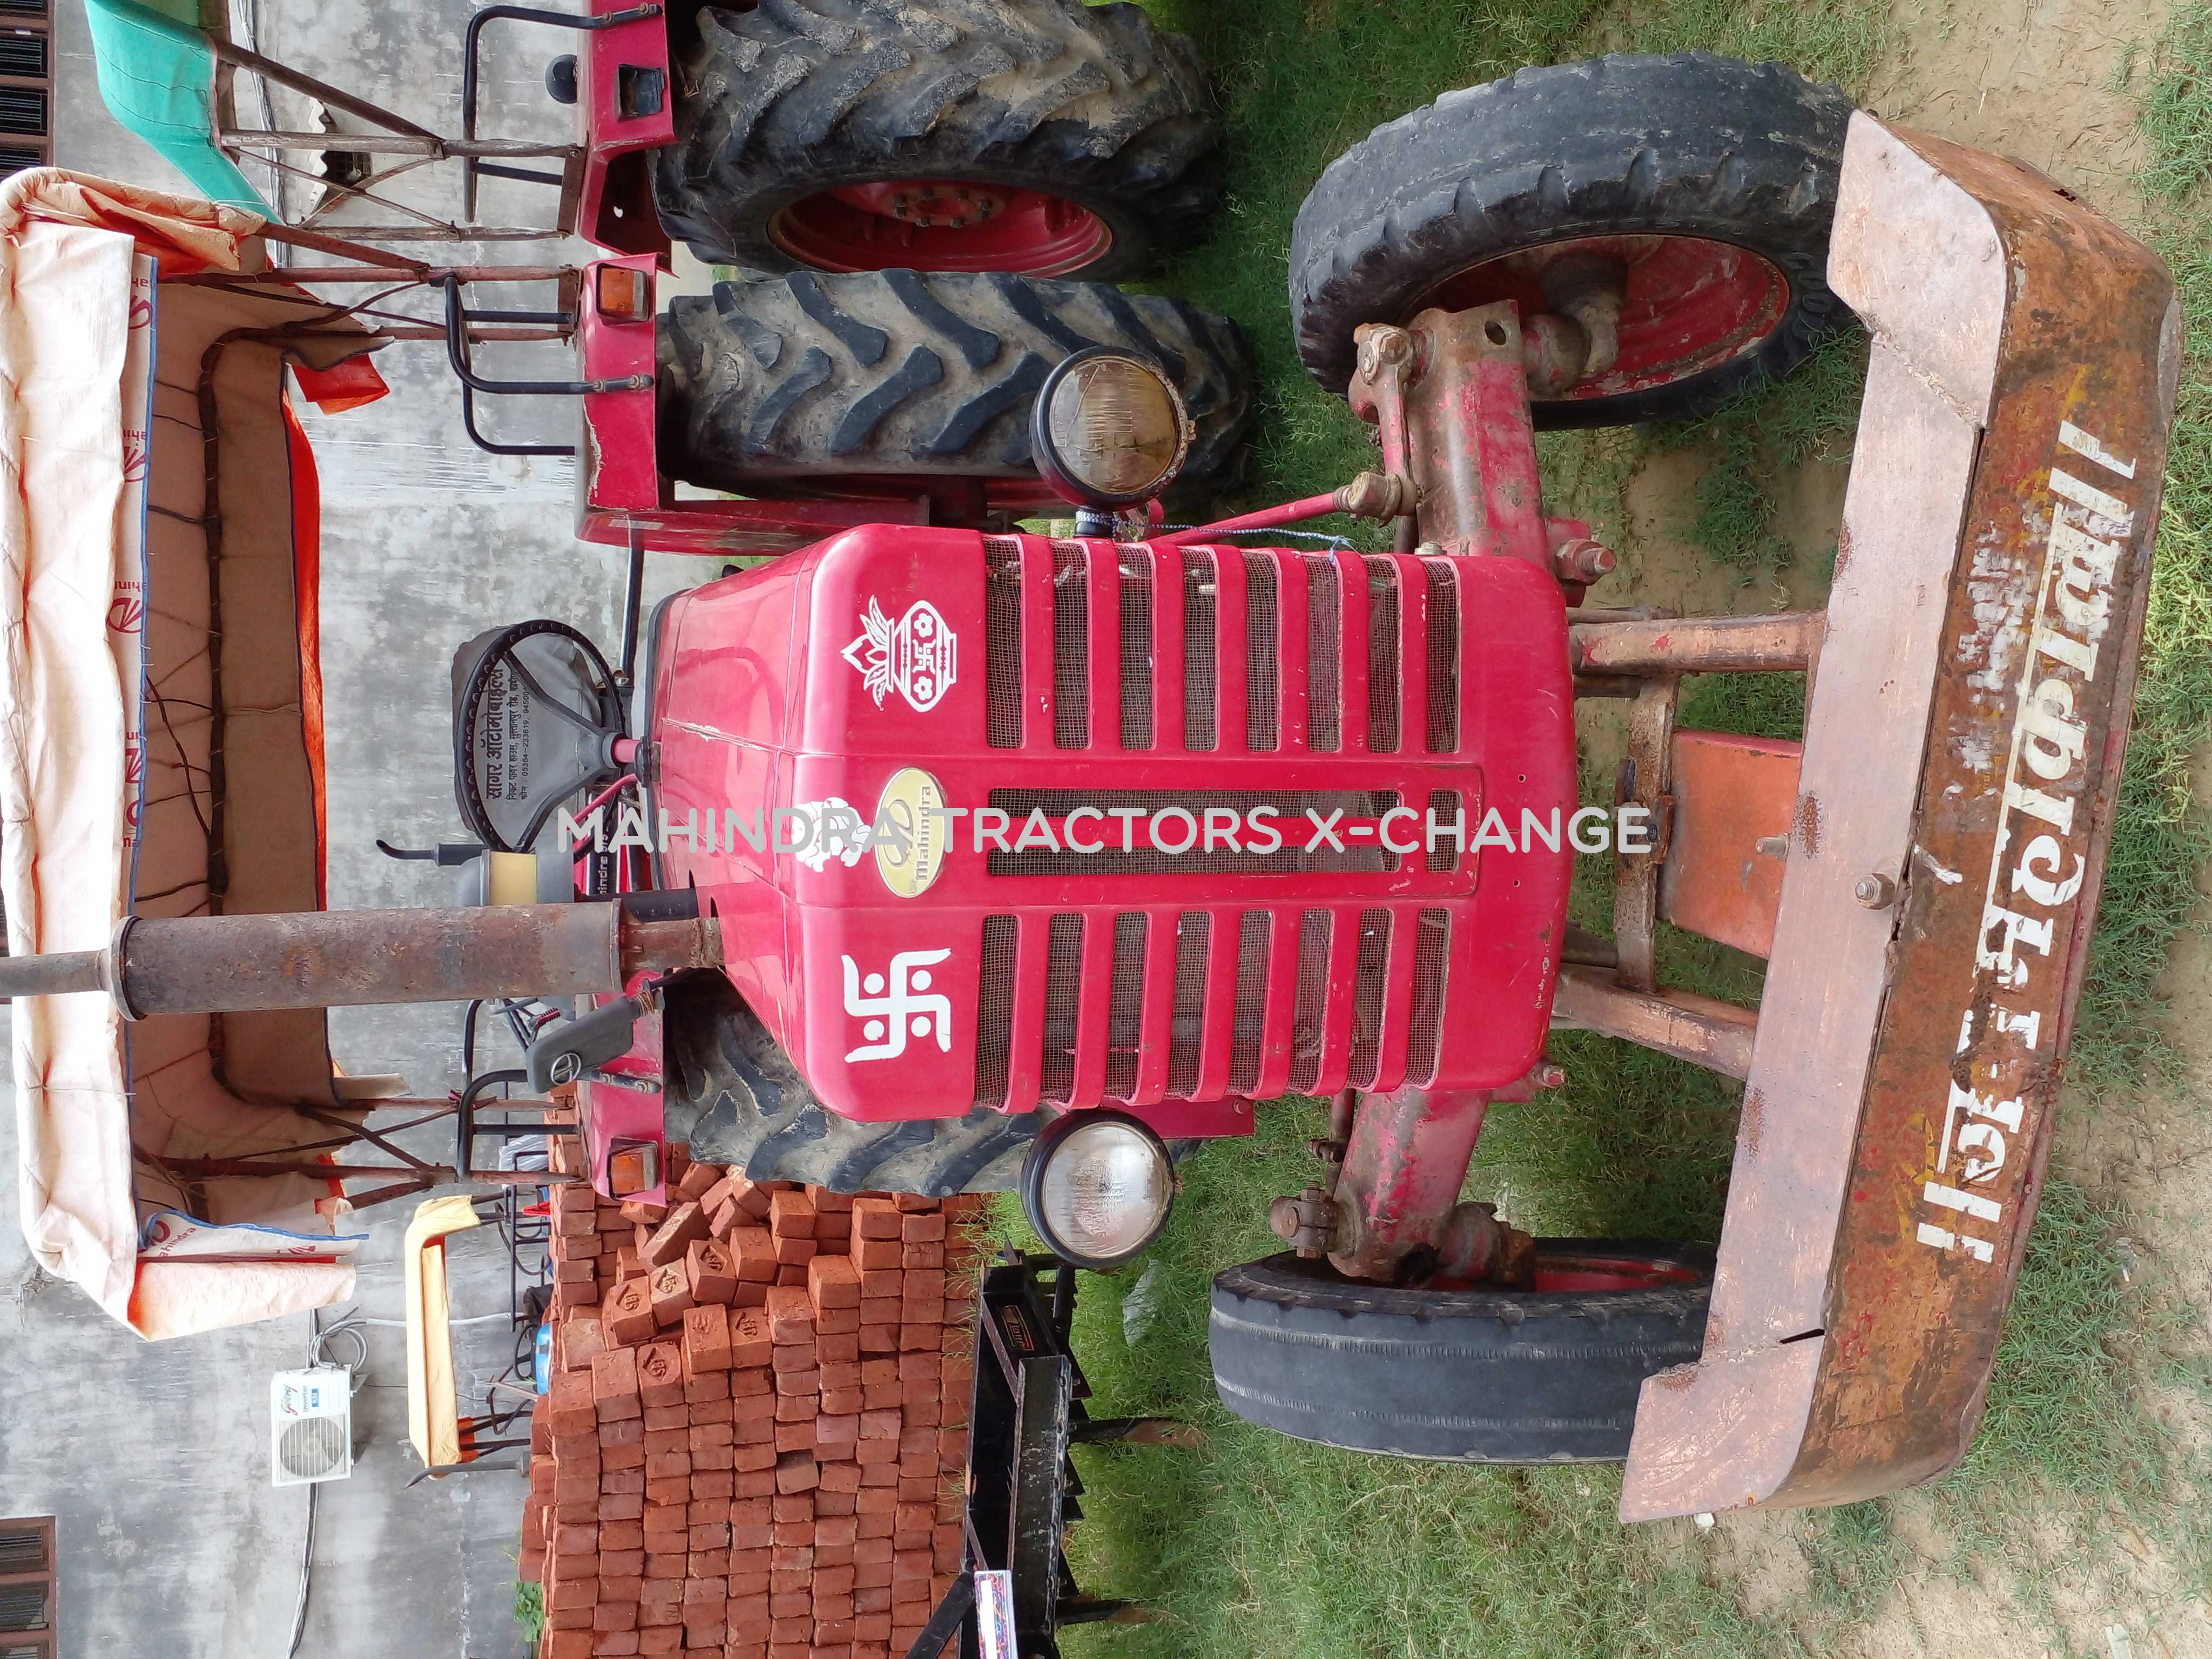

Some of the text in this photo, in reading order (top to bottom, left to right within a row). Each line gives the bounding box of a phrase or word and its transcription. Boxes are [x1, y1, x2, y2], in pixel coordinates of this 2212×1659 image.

[485, 763, 503, 800] सागर
[508, 765, 518, 780] पावर
[506, 783, 518, 800] निकट
[520, 786, 528, 800] फोन
[915, 786, 931, 881] Mahindra
[159, 1227, 197, 1257] ahindra
